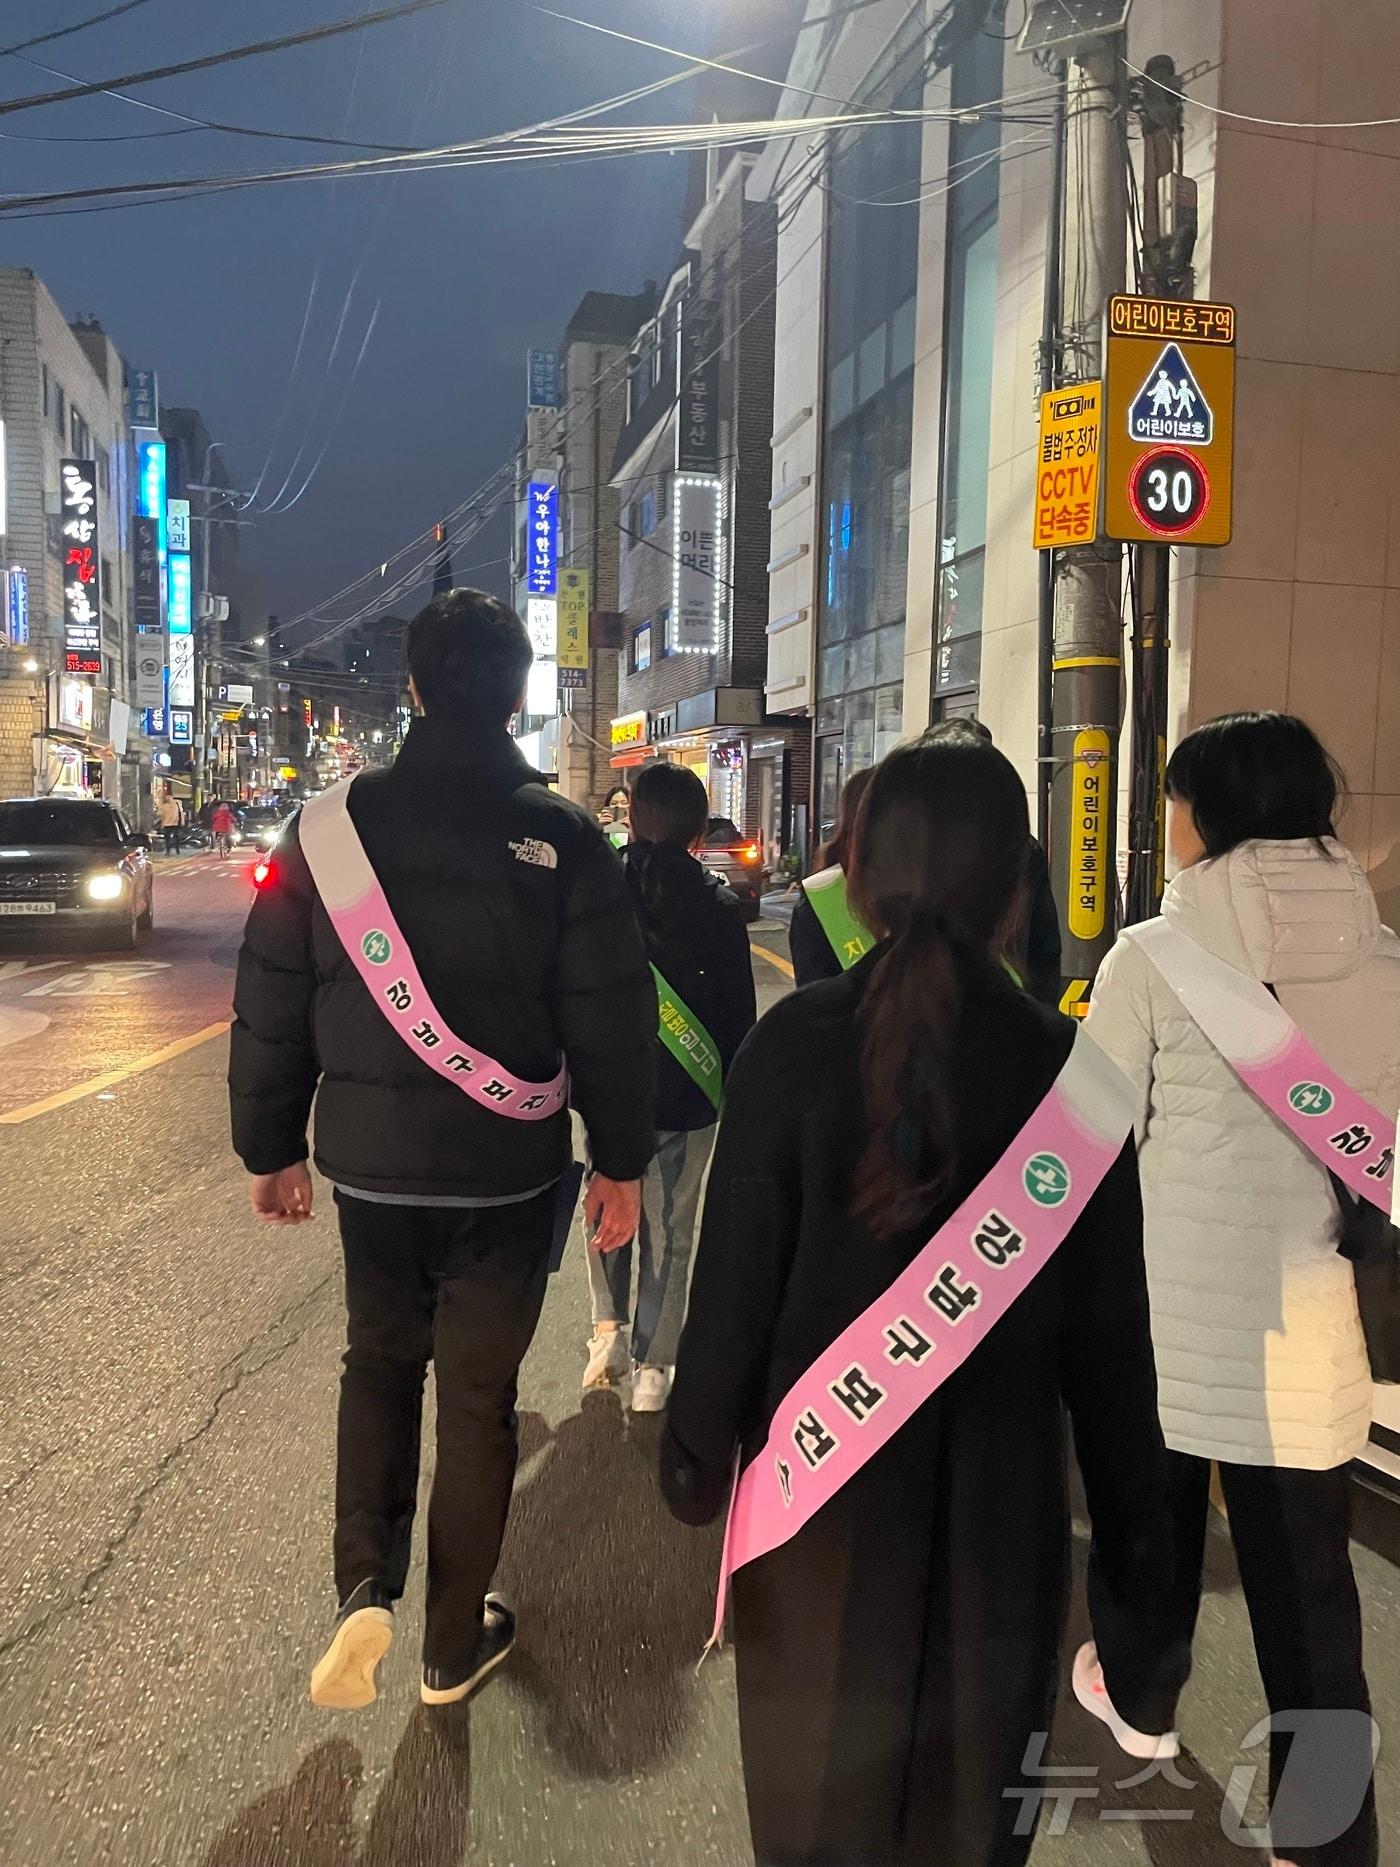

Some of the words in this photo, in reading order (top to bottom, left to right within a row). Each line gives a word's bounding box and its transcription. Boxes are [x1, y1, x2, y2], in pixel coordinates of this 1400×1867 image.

[1115, 302, 1230, 340] 어린이보호구역
[1136, 418, 1205, 438] 어린이보호
[1040, 464, 1095, 501] CCTV
[1147, 469, 1192, 513] 30
[172, 516, 186, 547] 치과
[1038, 501, 1091, 539] 단속중
[560, 601, 585, 611] TOP
[219, 686, 227, 699] P
[1080, 776, 1100, 912] 어린이보호구역
[386, 980, 561, 1111] 강남구보건
